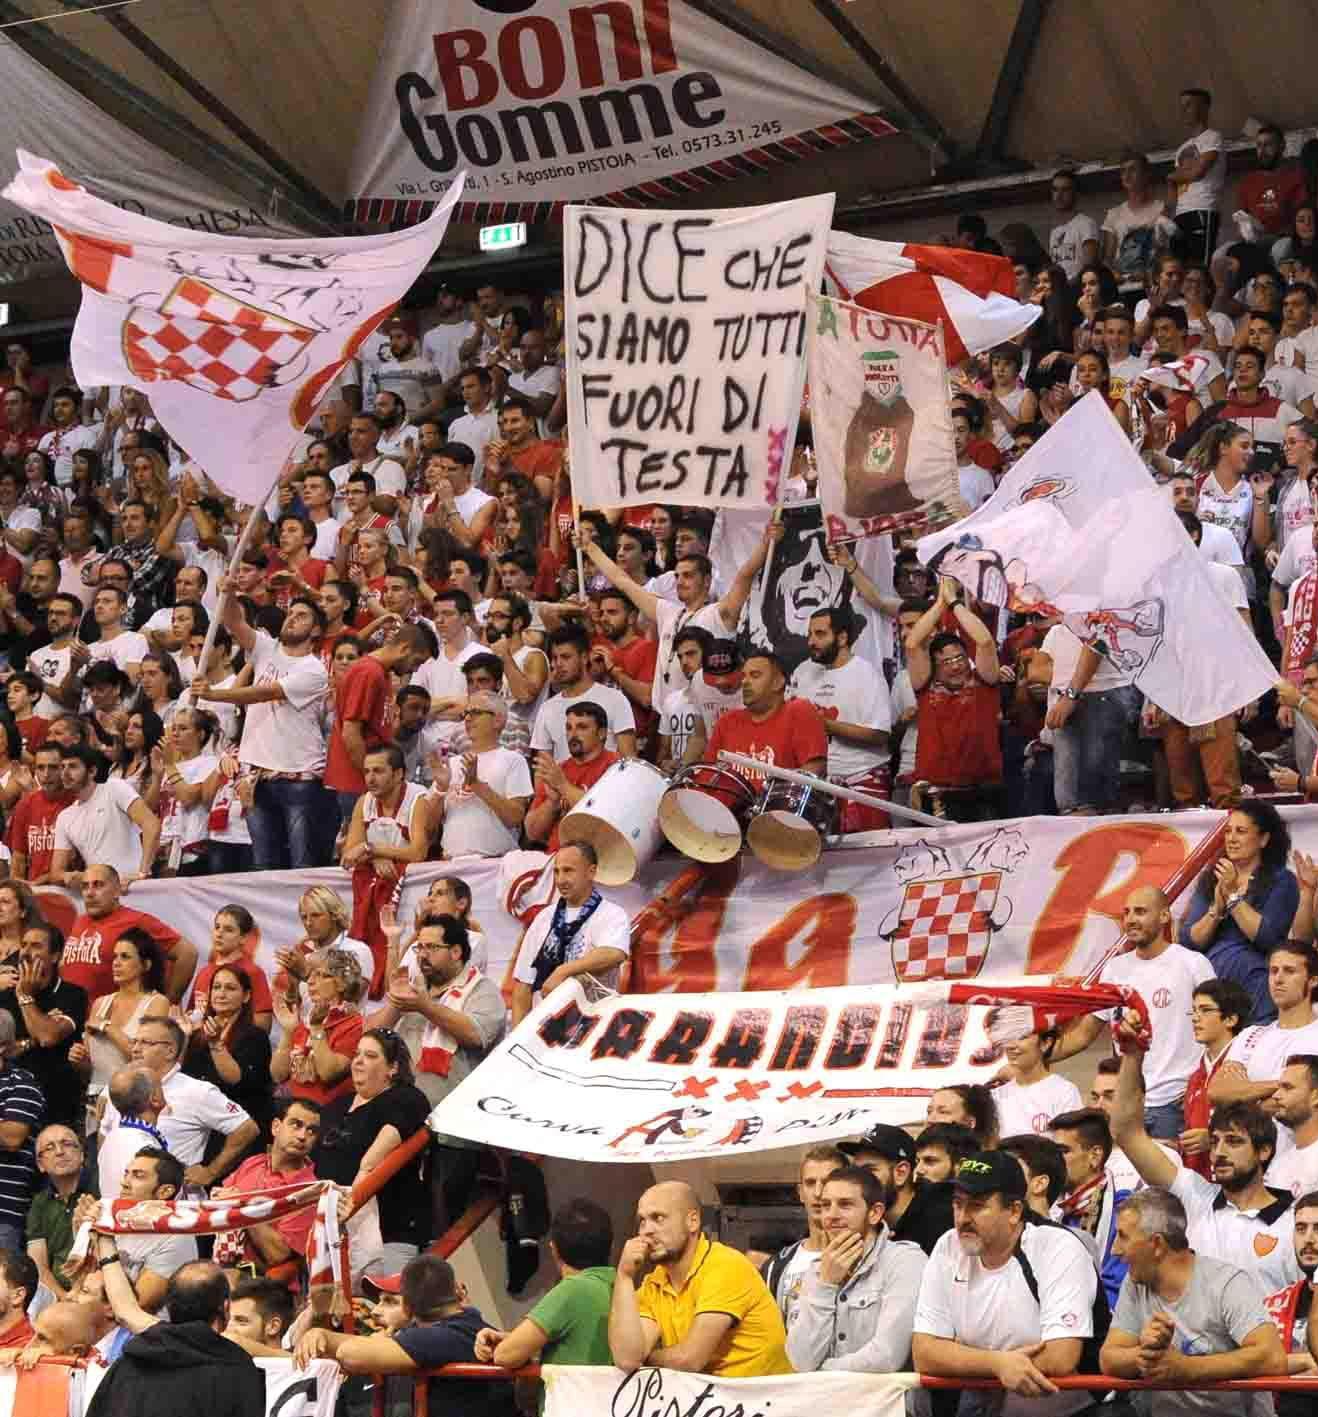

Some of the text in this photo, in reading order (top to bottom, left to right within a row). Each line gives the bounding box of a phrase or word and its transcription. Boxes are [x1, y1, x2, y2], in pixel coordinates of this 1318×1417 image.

[395, 71, 727, 172] Gomme
[517, 164, 576, 185] Agostino
[578, 154, 636, 176] PISTOIA
[652, 146, 680, 162] Tel.
[682, 120, 783, 154] 0573.31.245
[575, 213, 813, 304] DICE CHE
[576, 310, 807, 365] SIAMO TUTTI
[582, 372, 768, 435] FUORI DI
[599, 438, 749, 498] TESTA
